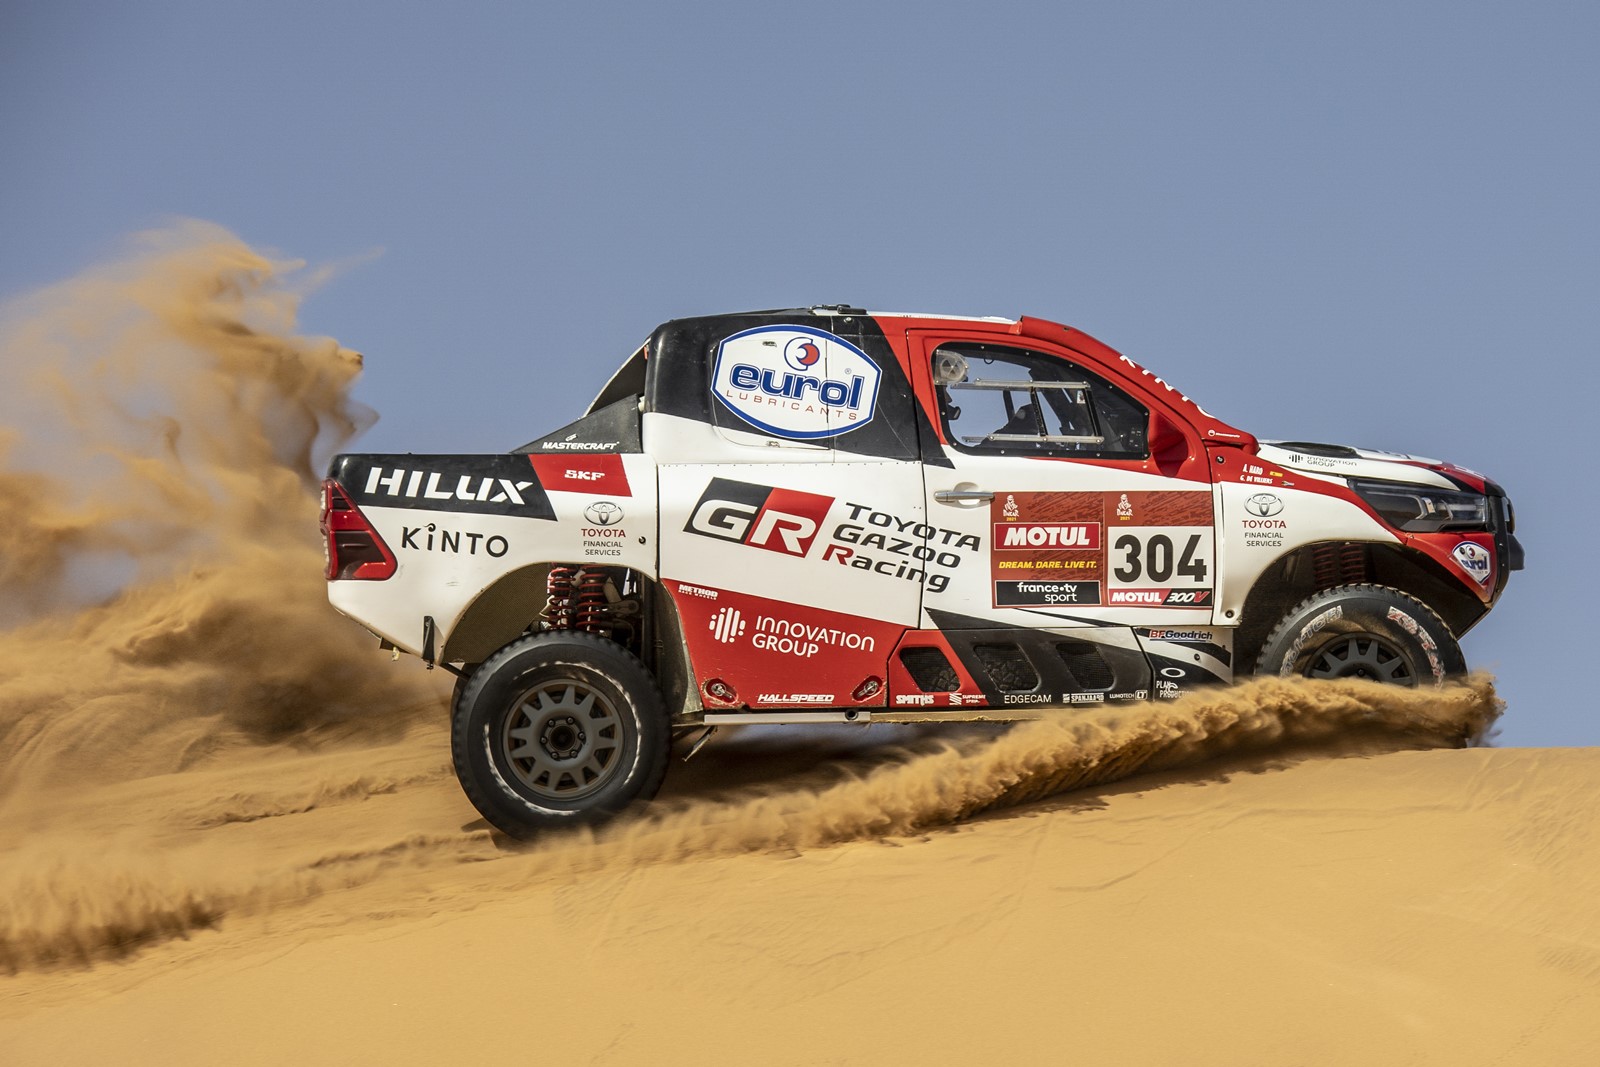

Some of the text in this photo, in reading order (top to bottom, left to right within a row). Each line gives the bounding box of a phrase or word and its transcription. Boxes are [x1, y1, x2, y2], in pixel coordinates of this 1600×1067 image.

[730, 363, 865, 410] eurol
[726, 390, 857, 420] LUBRICANTS
[542, 441, 617, 450] MASTERCRAFT
[1307, 456, 1357, 466] INNOVATION
[564, 469, 605, 481] SKF
[364, 467, 533, 505] HILUX
[691, 499, 817, 555] GR
[845, 502, 981, 552] TOYOTA
[1242, 520, 1286, 529] TOYOTA
[581, 529, 626, 538] TOYOTA
[1003, 527, 1090, 546] MOTUL
[832, 523, 961, 569] GAZOO
[1114, 534, 1207, 582] 304
[821, 544, 951, 593] Racing
[999, 561, 1034, 569] DREAM.
[1036, 561, 1063, 569] DARE.
[1064, 561, 1086, 569] LIVE
[679, 584, 718, 597] METHOD
[1112, 591, 1210, 603] MOTUL 300V
[1044, 593, 1077, 604] sport
[755, 615, 875, 652] INNOVATION
[752, 633, 819, 658] GROUP
[757, 693, 835, 703] HALLSPEED
[896, 695, 934, 704] SMITHS
[1004, 694, 1051, 704] EDGECAM
